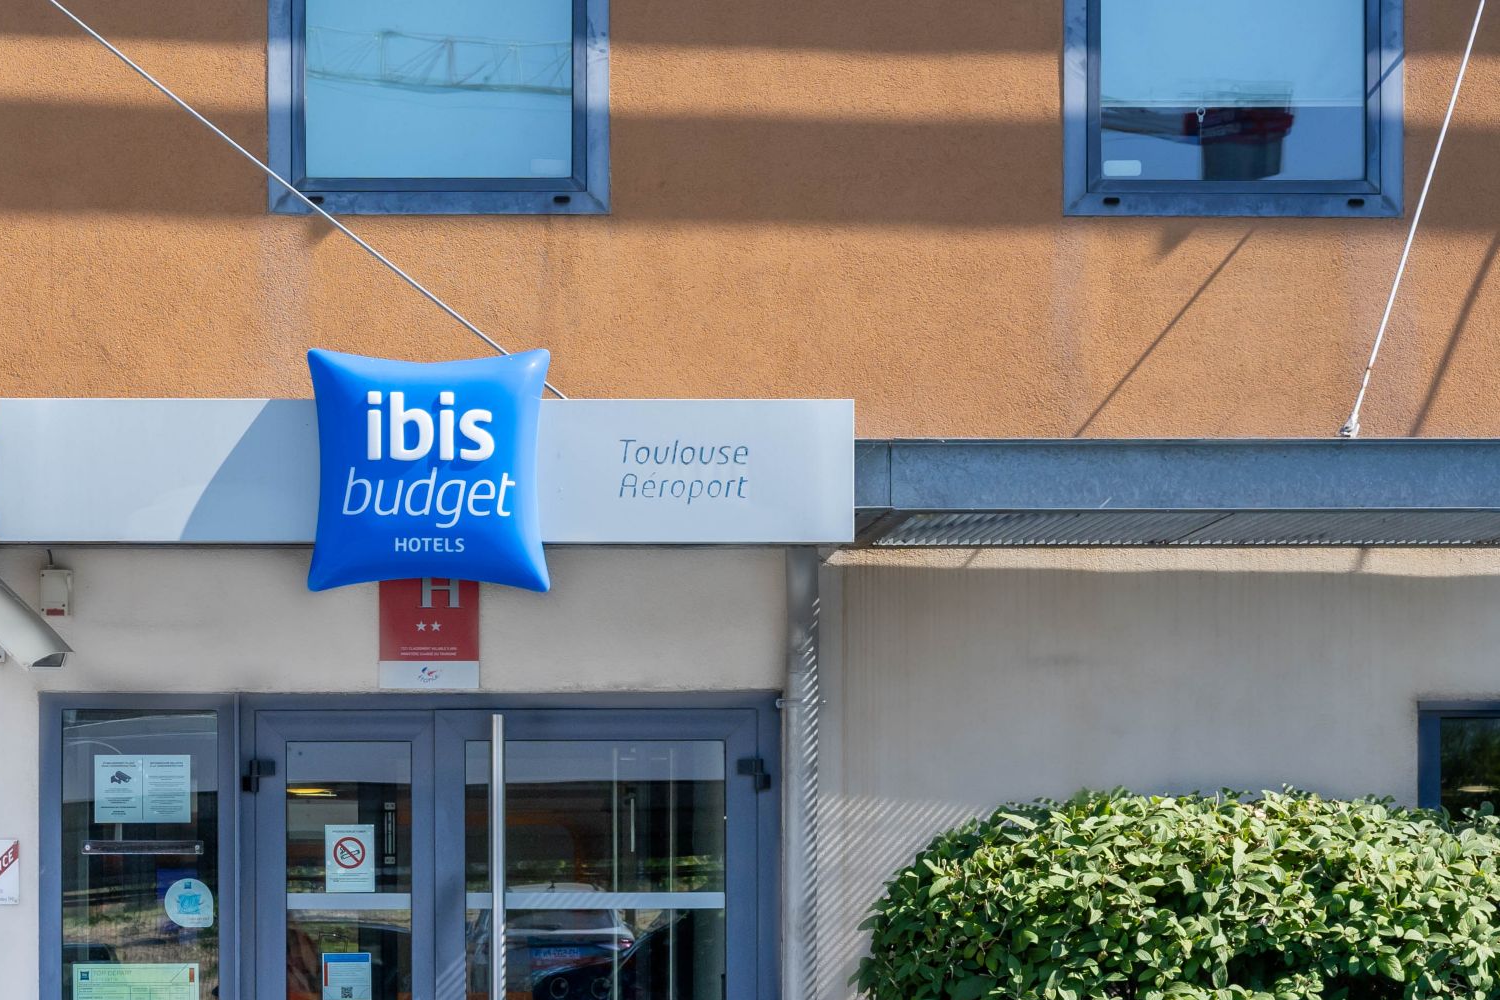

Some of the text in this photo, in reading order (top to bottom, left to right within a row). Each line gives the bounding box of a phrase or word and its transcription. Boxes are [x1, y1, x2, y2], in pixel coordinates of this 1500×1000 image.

[367, 391, 495, 461] ibis
[619, 439, 749, 466] Toulouse
[342, 467, 516, 529] budget
[619, 471, 749, 505] Aéroport
[394, 537, 465, 553] HOTELS
[417, 578, 464, 609] H
